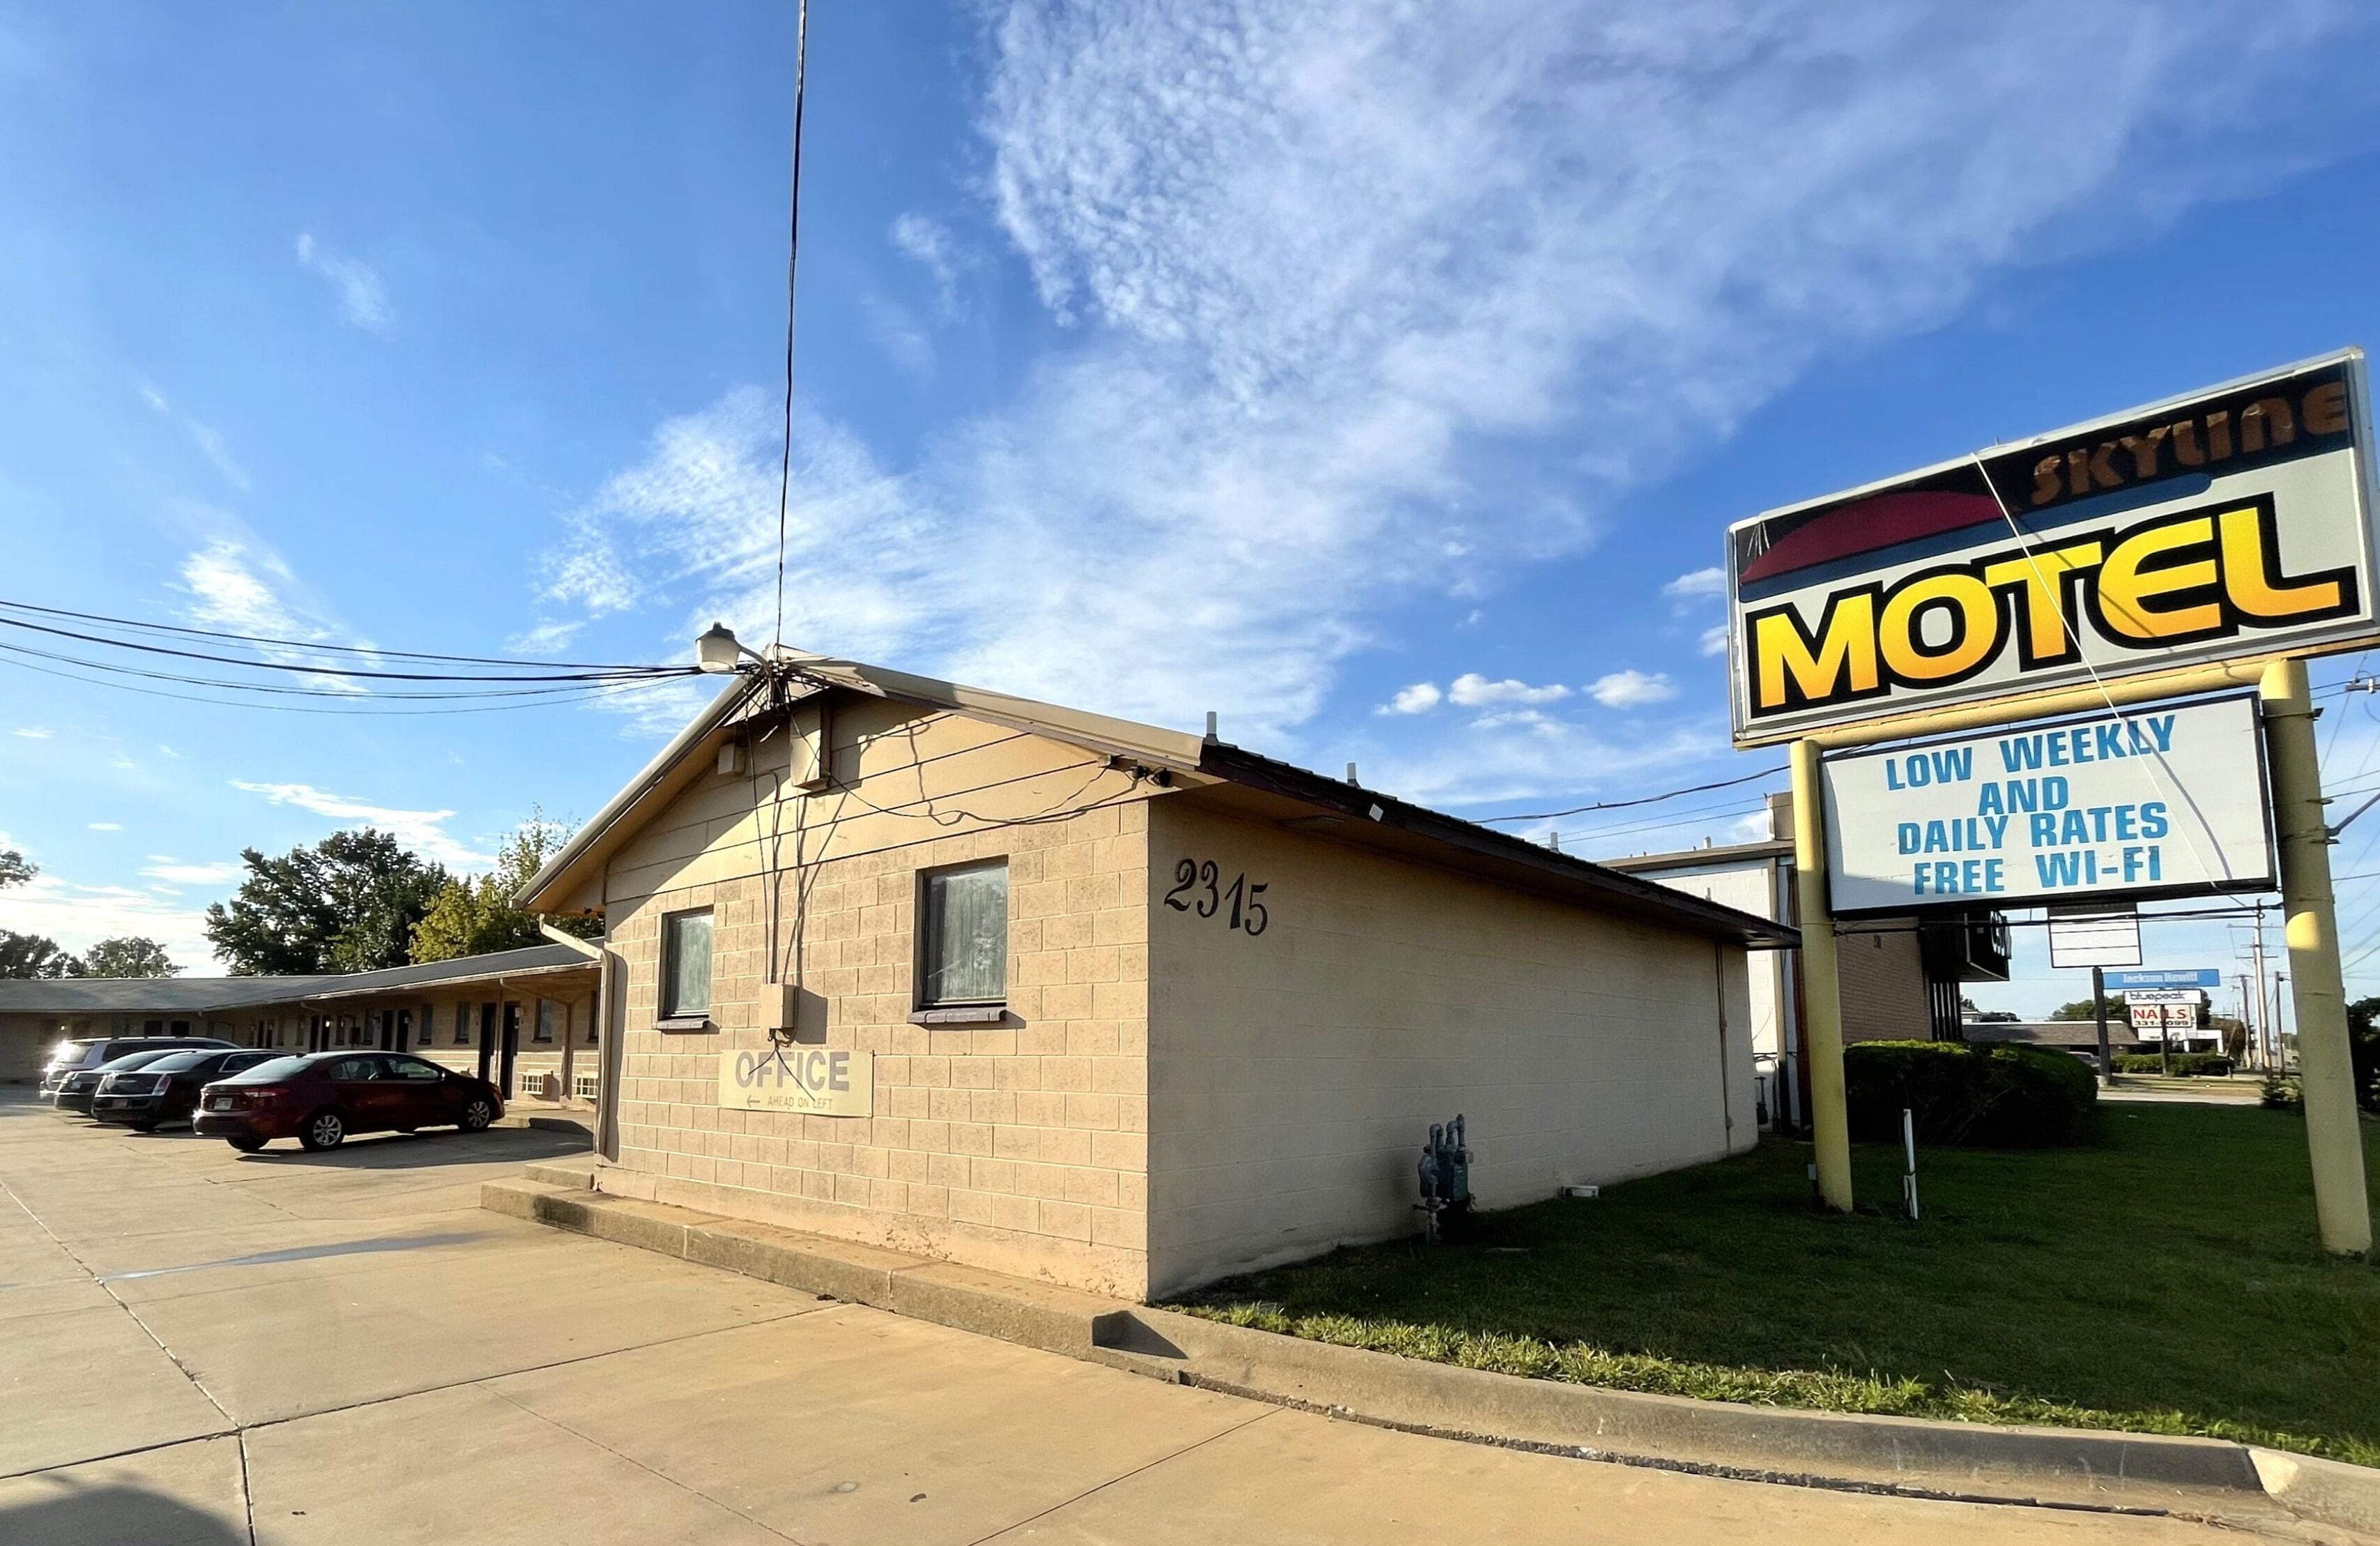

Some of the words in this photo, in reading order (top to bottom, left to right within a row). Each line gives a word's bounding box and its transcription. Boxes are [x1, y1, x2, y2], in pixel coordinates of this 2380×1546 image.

[1751, 503, 2347, 713] MOTEL
[1886, 748, 1972, 791] LOW
[1999, 714, 2175, 773] WEEKLY
[1978, 775, 2068, 817] AND
[1898, 815, 2008, 855] DAILY
[2029, 802, 2168, 848] RATES
[1914, 858, 2005, 896] FREE
[2035, 846, 2161, 888] WI-FI
[1164, 858, 1269, 937] 2315
[2129, 991, 2187, 1002] bluepeak
[2133, 1009, 2187, 1020] NALS
[735, 1050, 850, 1092] OFFICE
[767, 1096, 794, 1107] AHEAD
[798, 1097, 809, 1108] ON
[813, 1099, 833, 1109] LEFT
